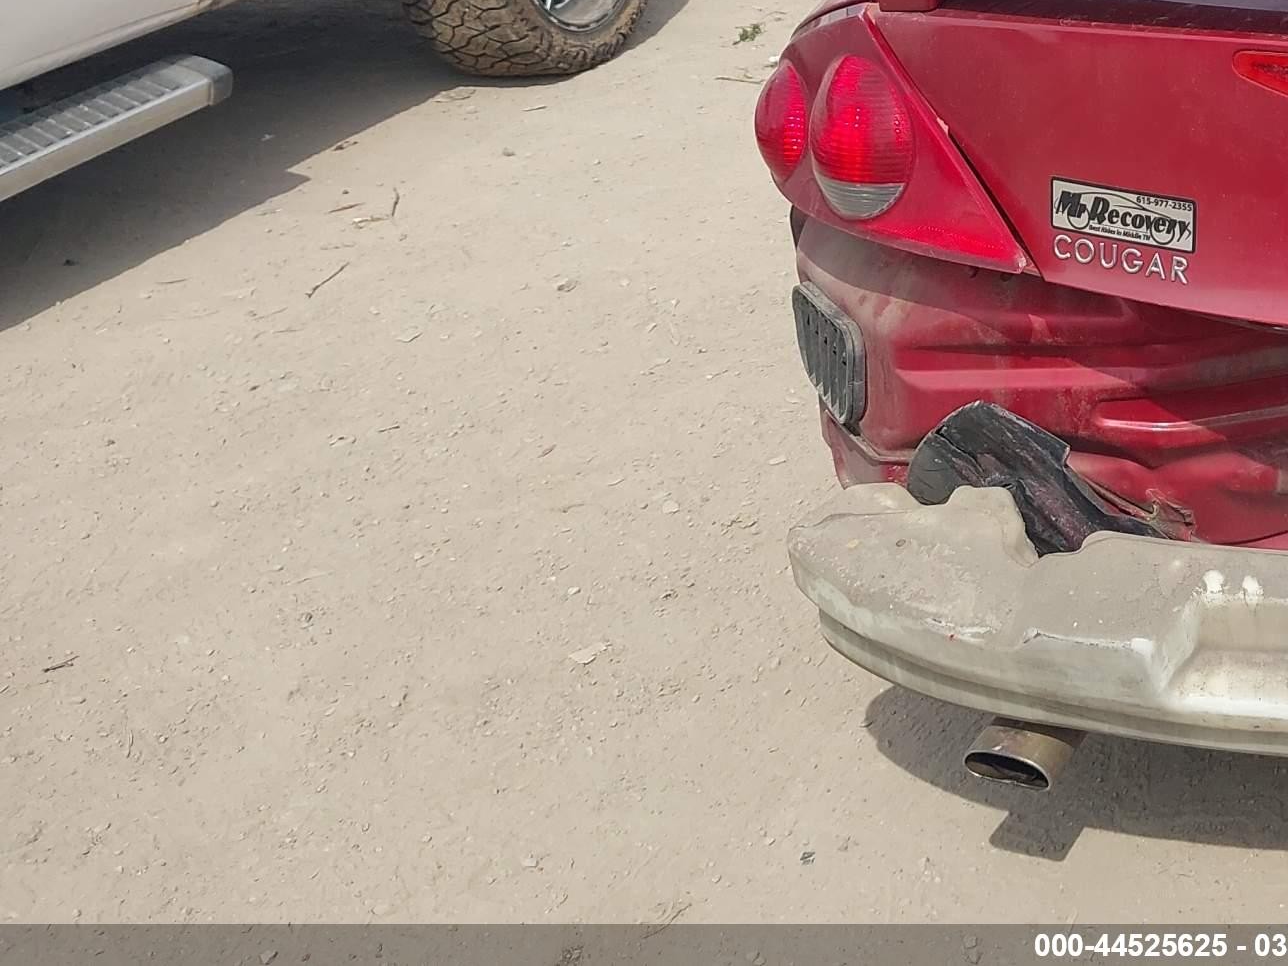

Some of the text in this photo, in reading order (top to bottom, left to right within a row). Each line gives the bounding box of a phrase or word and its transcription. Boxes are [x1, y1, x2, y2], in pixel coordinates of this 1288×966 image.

[1089, 196, 1191, 242] Recovery
[1136, 195, 1193, 212] 615-977-2355
[1054, 234, 1188, 284] COUGAR
